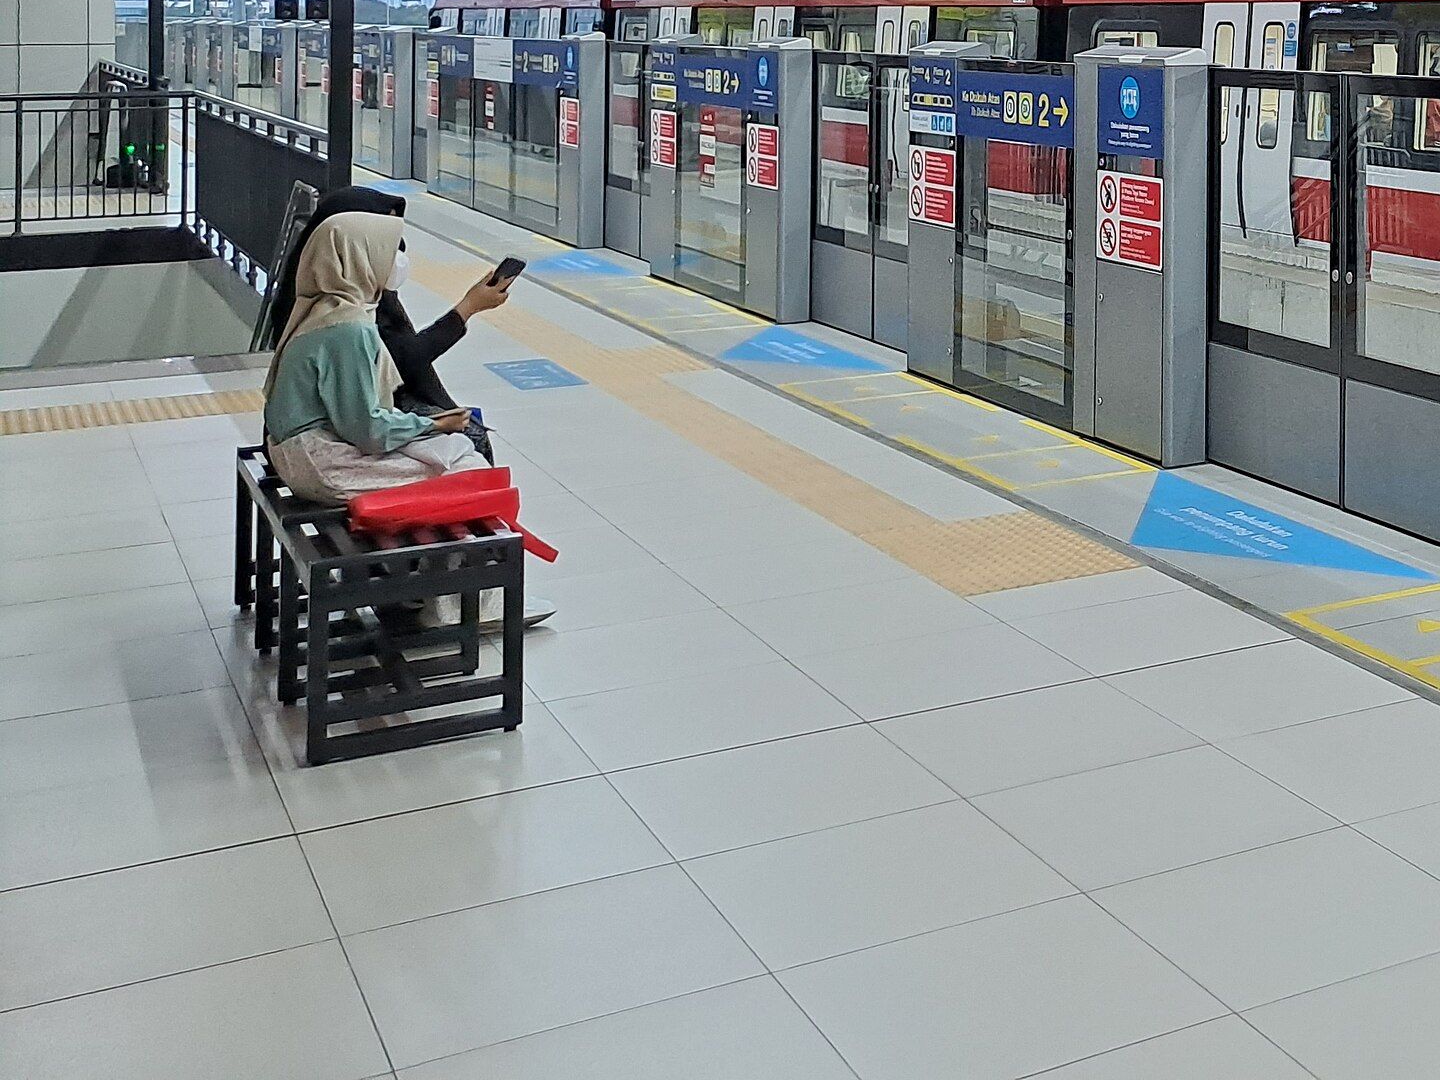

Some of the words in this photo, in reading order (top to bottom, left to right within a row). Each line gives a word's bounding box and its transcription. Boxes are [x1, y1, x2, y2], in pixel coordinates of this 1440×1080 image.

[723, 70, 730, 95] 2
[924, 67, 931, 84] 4
[945, 69, 951, 86] 2
[1038, 93, 1050, 127] 2
[1250, 534, 1289, 551] turun
